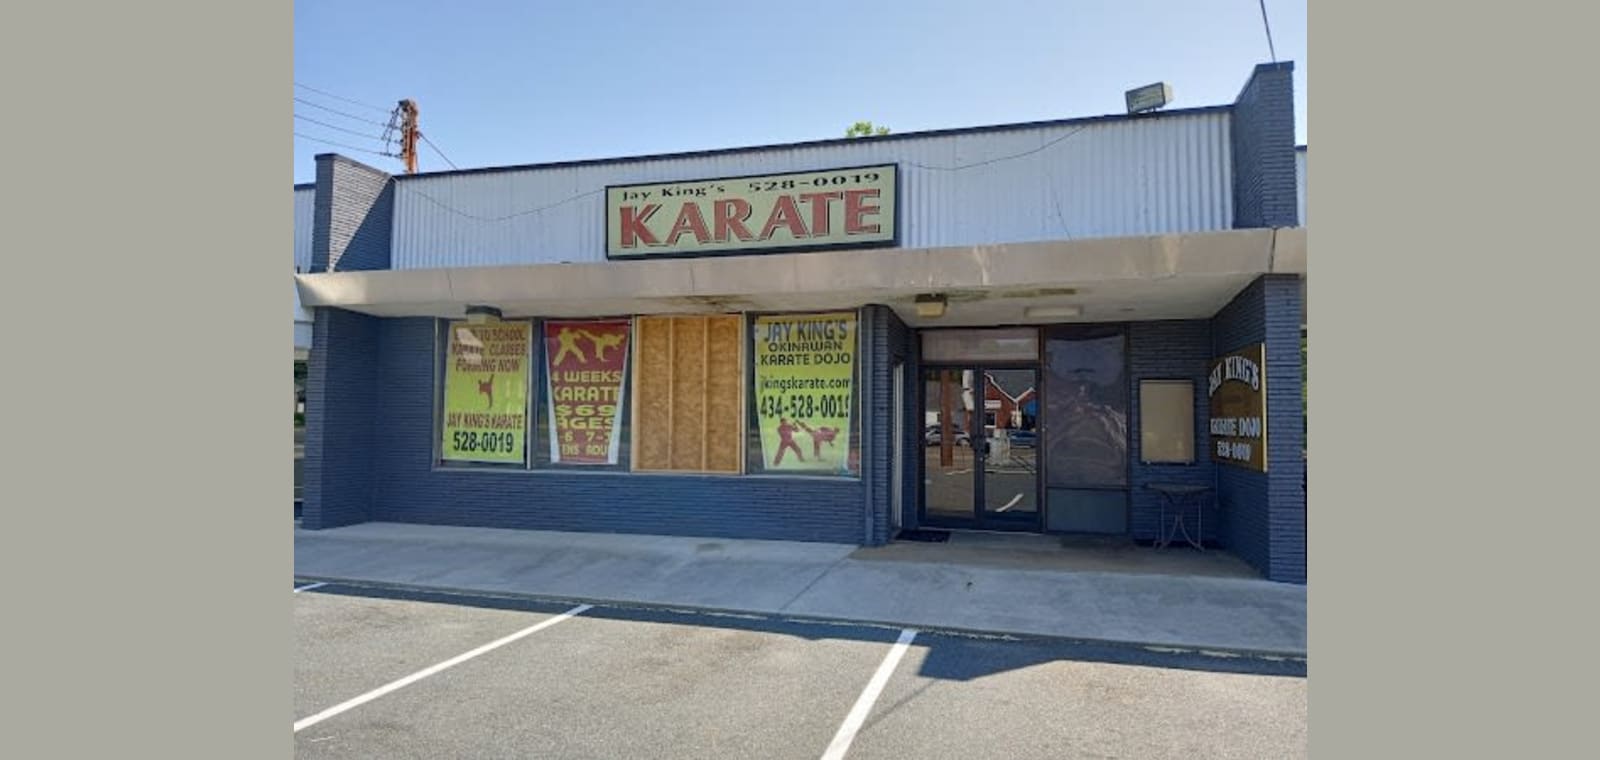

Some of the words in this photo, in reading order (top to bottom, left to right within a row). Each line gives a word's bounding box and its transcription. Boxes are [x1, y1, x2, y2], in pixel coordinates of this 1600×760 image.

[622, 190, 651, 201] Jay
[662, 184, 725, 198] King's
[750, 173, 879, 192] 528-0019
[619, 188, 881, 248] KARATE
[764, 322, 793, 342] JAY
[797, 319, 848, 342] KING'S
[768, 341, 843, 352] OKINAWAN
[498, 358, 521, 372] NOW
[760, 354, 810, 366] KARATE
[814, 352, 850, 365] DOJO
[564, 370, 622, 383] WEEKS
[1225, 355, 1259, 391] KING'S
[448, 412, 462, 428] JAY
[491, 413, 523, 430] KARATE
[453, 431, 514, 453] 528-0019
